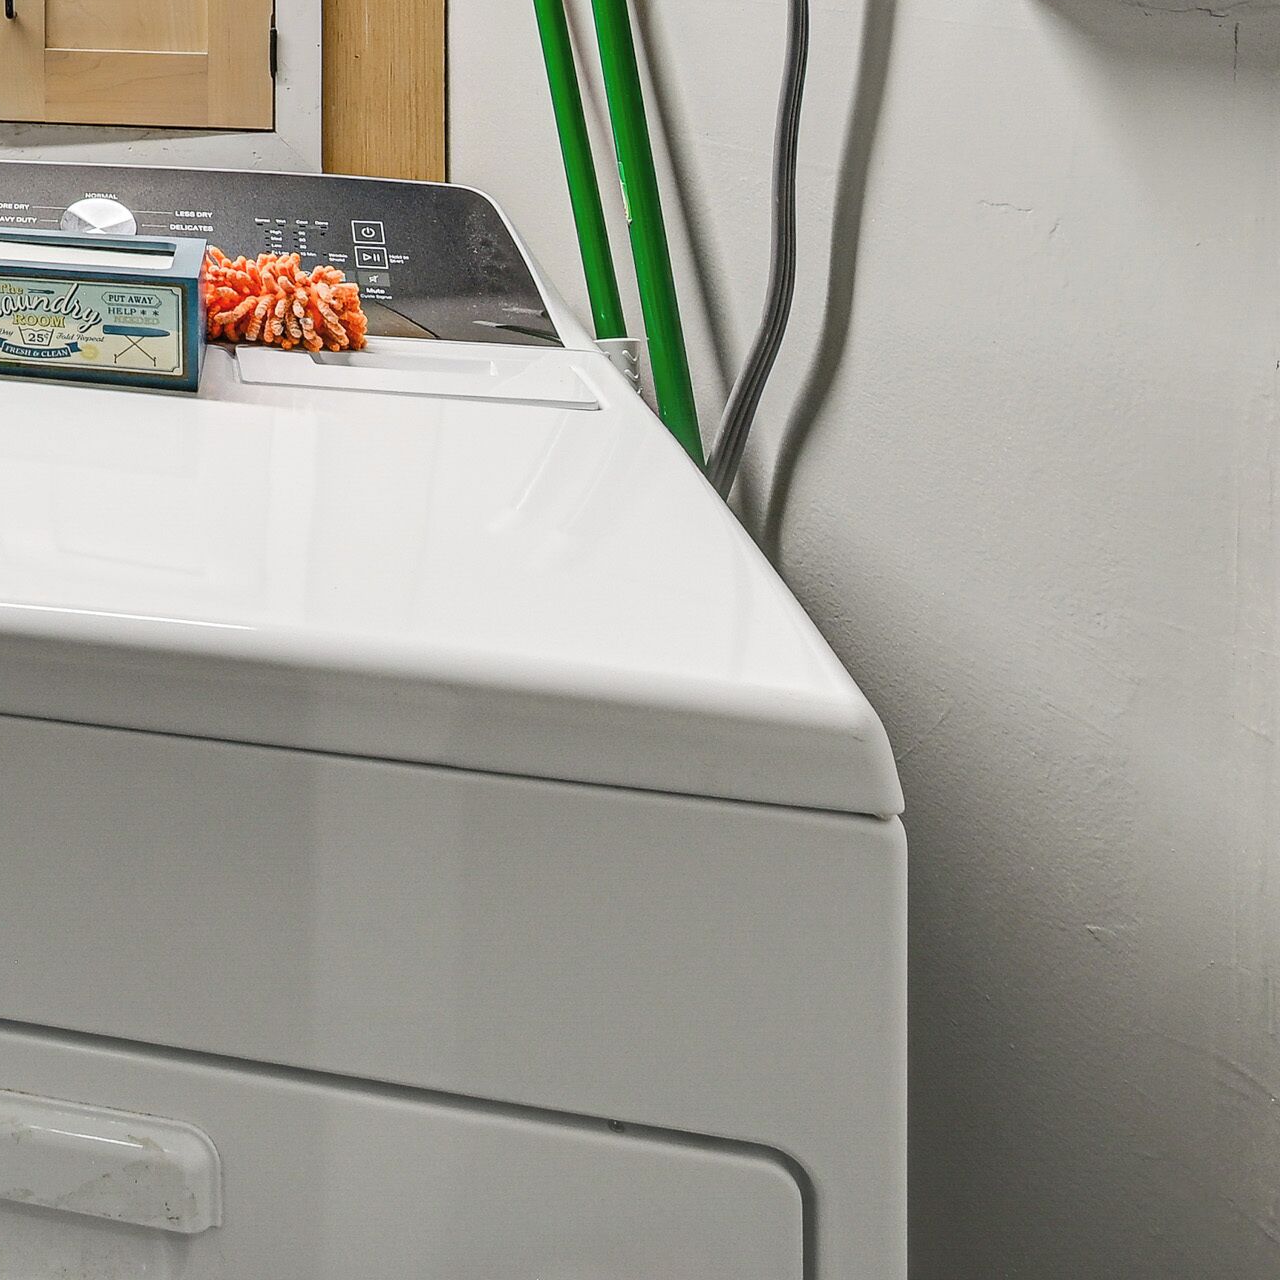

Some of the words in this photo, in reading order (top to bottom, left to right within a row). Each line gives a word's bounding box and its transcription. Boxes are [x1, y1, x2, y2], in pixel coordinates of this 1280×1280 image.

[84, 192, 118, 200] NORMAL
[175, 210, 195, 218] LESS
[169, 223, 214, 232] DELICATES
[366, 287, 385, 295] Mute
[108, 294, 126, 303] PUT
[127, 295, 154, 304] AWAY
[107, 306, 137, 315] HELP
[12, 313, 66, 328] ROOM
[75, 334, 105, 343] Repeat
[4, 345, 31, 356] FRESH
[40, 348, 69, 358] CLEAN
